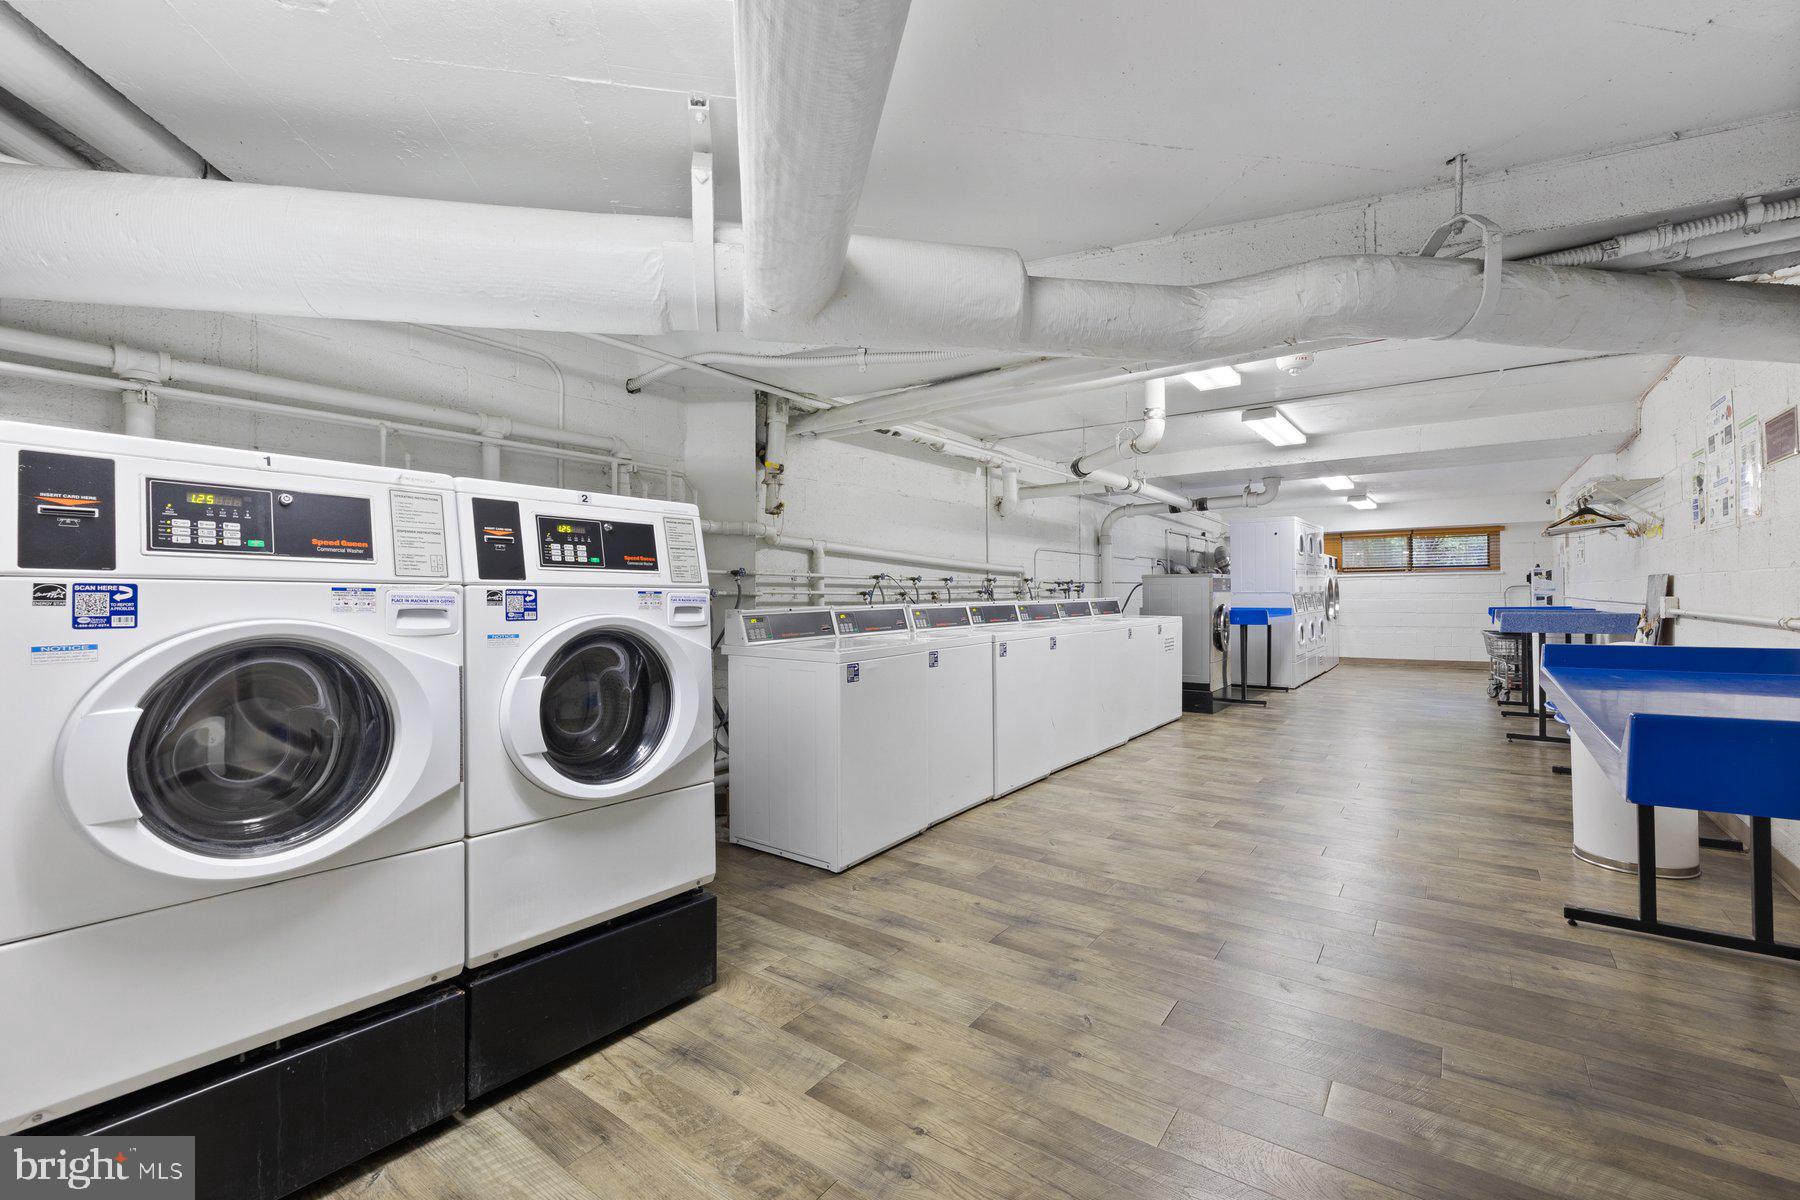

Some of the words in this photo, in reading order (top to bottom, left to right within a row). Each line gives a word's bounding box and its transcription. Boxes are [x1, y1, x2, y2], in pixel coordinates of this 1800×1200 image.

[263, 456, 271, 466] 1
[581, 494, 589, 503] 2
[312, 538, 340, 546] Speed
